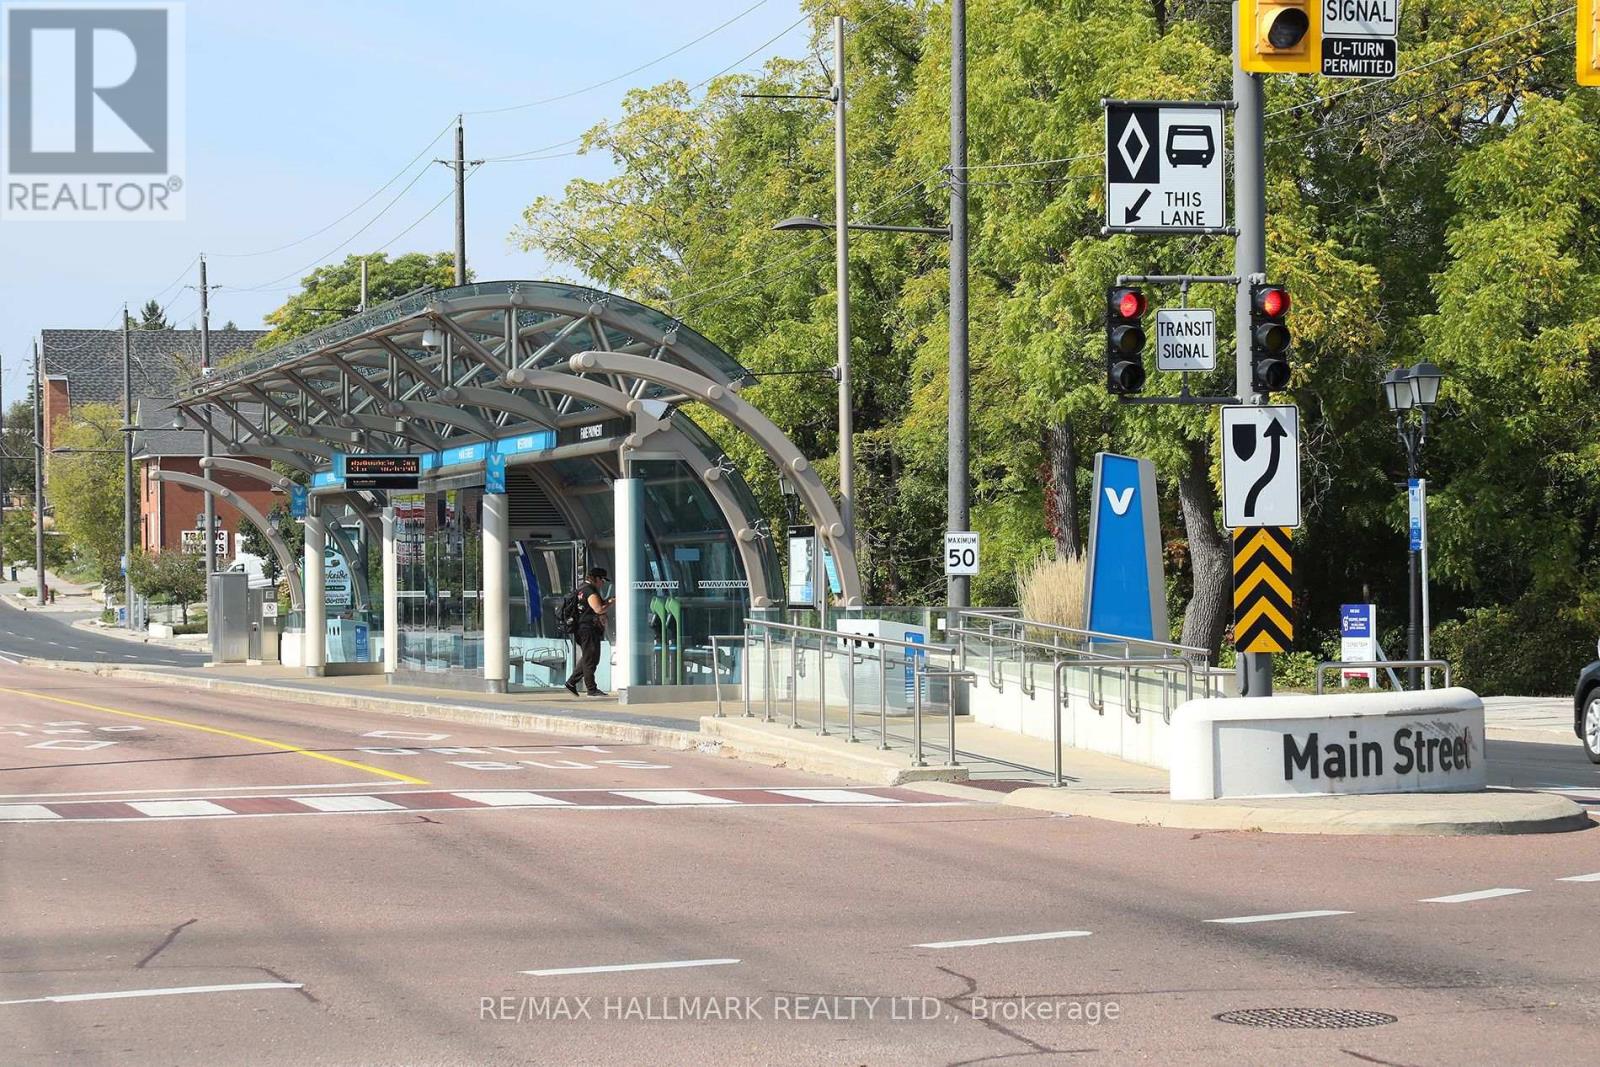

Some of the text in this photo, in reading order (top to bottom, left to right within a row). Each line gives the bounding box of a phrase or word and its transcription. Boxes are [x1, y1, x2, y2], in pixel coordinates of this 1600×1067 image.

[1326, 0, 1393, 22] SIGNAL
[1333, 41, 1385, 57] U-TURN
[1323, 58, 1394, 74] PERMITTED
[1164, 191, 1202, 207] THIS
[1161, 210, 1206, 226] LANE
[1159, 321, 1213, 337] TRANSIT
[1163, 343, 1209, 359] SIGNAL
[184, 532, 224, 541] TRAIC
[947, 537, 977, 545] MAXIMUM
[949, 548, 975, 567] 50
[1283, 727, 1472, 780] Main Street
[449, 759, 673, 771] BUS
